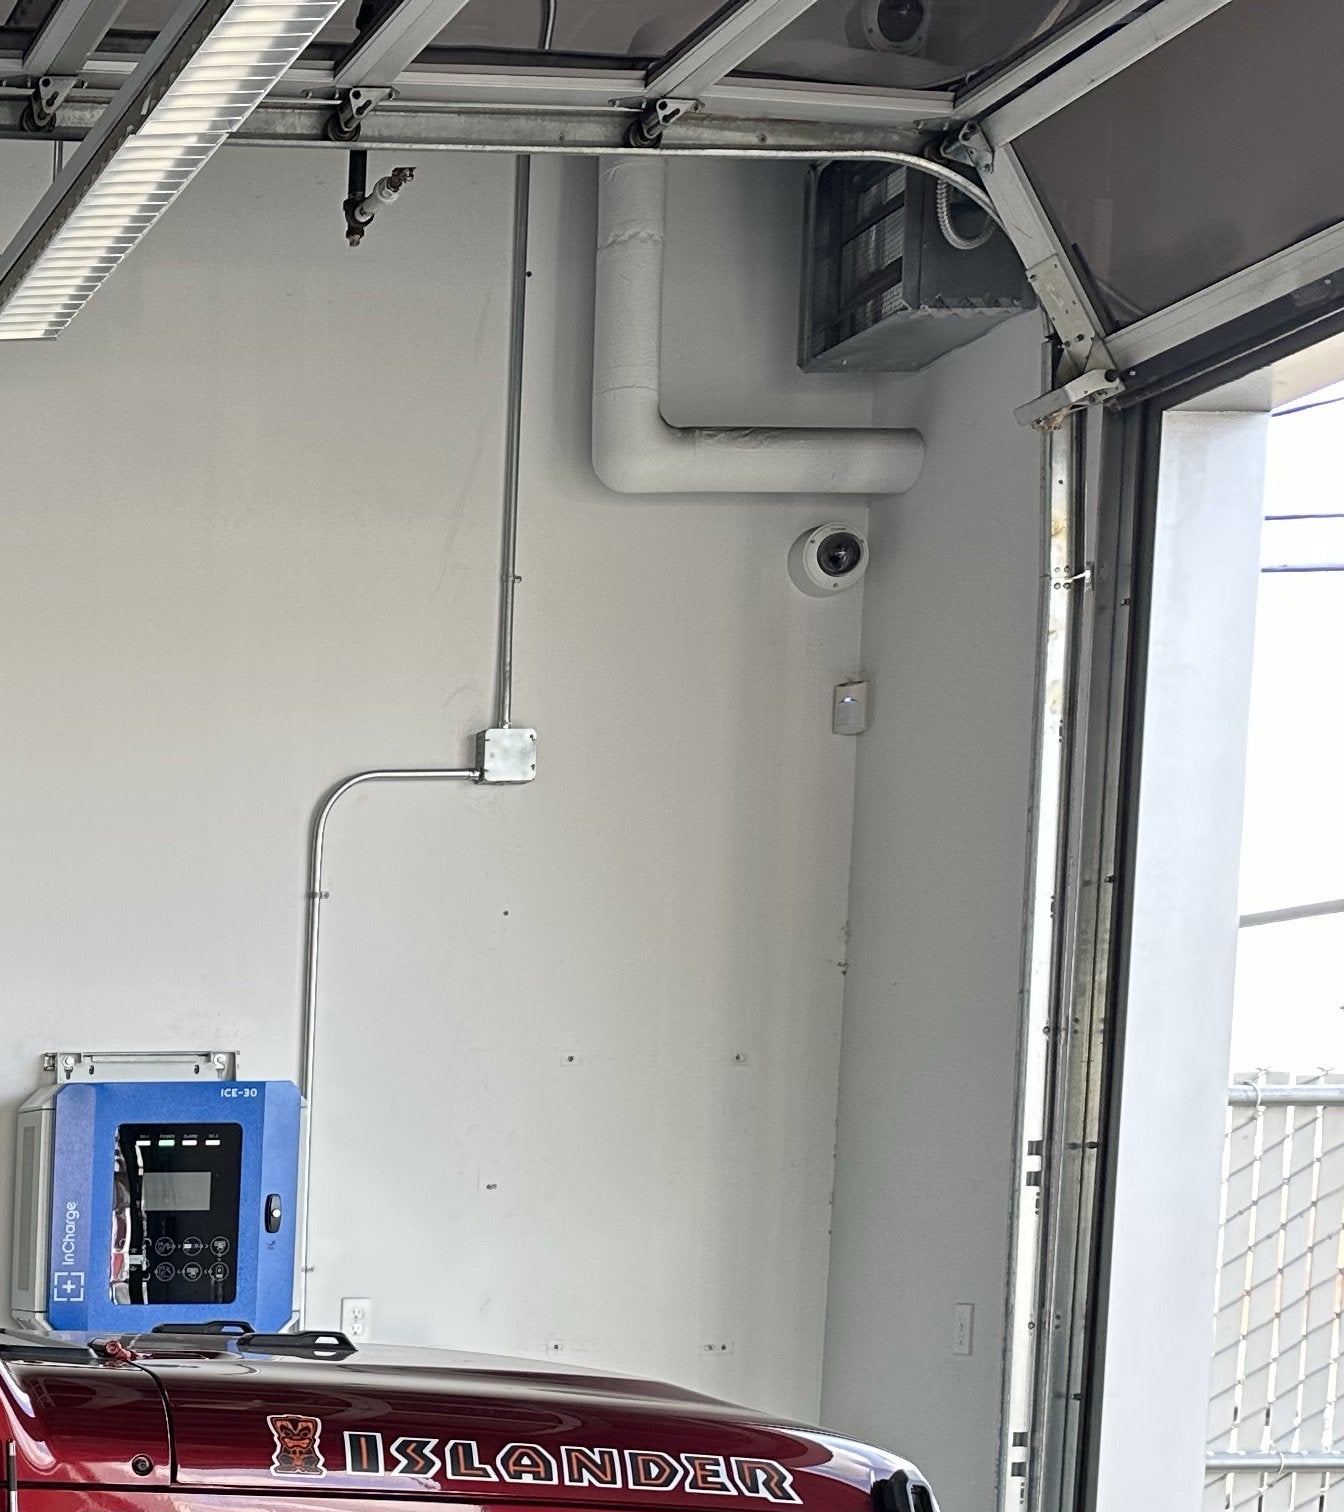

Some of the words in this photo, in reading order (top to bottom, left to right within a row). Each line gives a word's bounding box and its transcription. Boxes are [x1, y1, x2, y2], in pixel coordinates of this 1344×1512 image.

[220, 1088, 258, 1098] ICE-30
[61, 1201, 80, 1266] InCharge
[343, 1430, 804, 1504] ISLANDER
